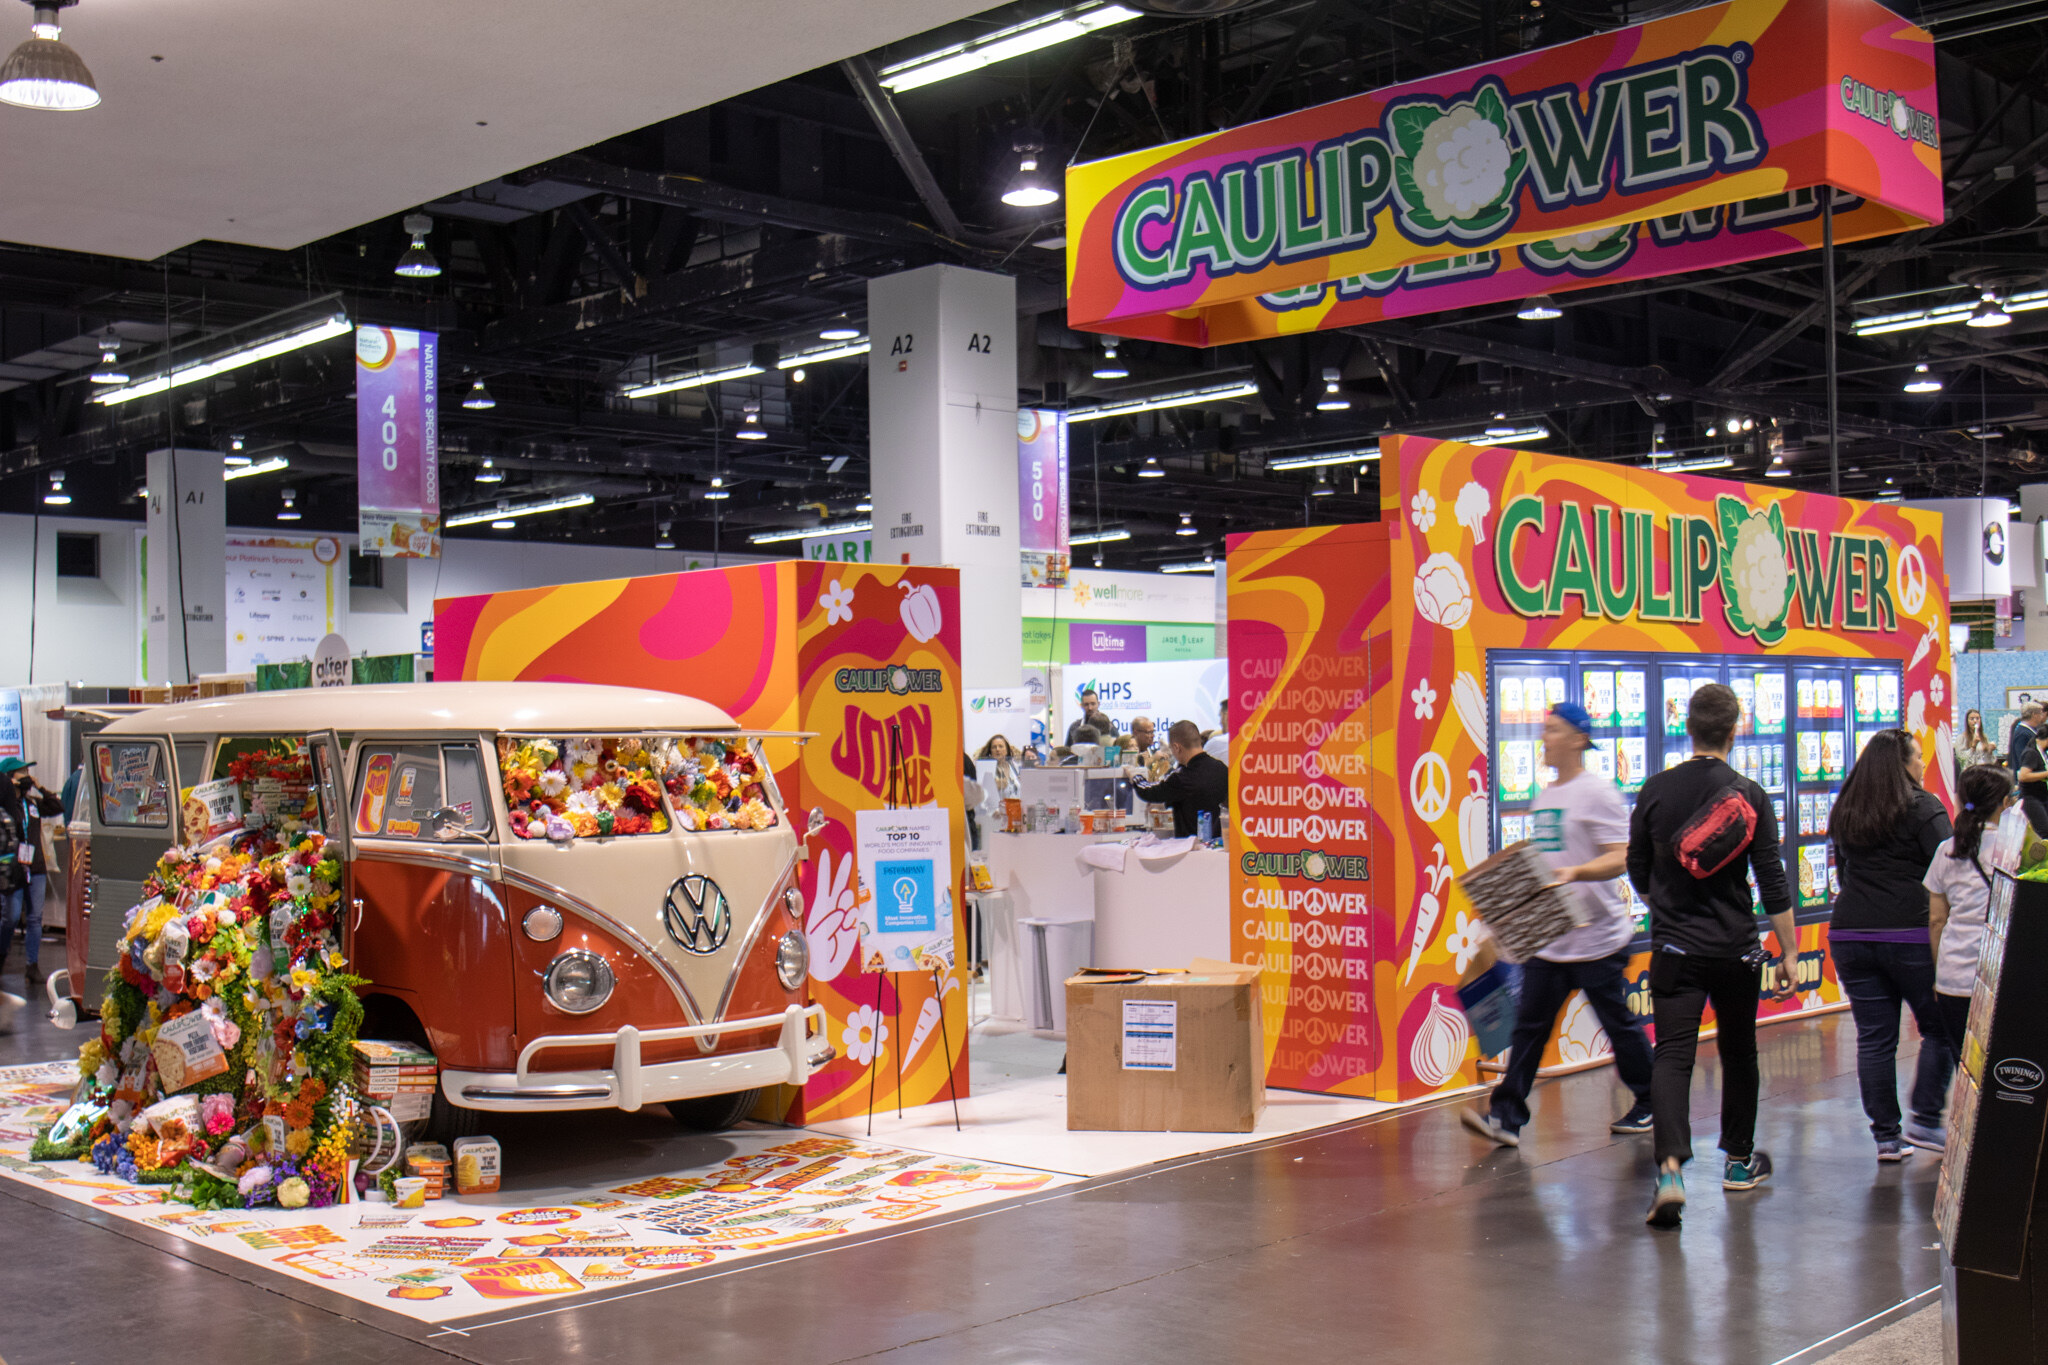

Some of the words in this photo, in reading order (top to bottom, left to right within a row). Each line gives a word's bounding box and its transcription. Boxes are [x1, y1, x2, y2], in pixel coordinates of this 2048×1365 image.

[890, 333, 913, 356] A2
[968, 333, 991, 354] A2
[424, 343, 433, 391] NATURAL
[425, 393, 434, 403] &
[382, 394, 397, 471] 400
[425, 408, 435, 465] SPECIALTY
[426, 465, 436, 504] FOODS
[1031, 461, 1043, 521] 500
[901, 512, 912, 524] FIRE
[977, 511, 988, 523] FIRE
[890, 524, 924, 539] EXTINGUISHER
[966, 523, 1000, 537] EXTINGUISHER
[240, 554, 271, 562] Platinum
[272, 556, 304, 565] Sponsors
[835, 664, 943, 695] CAULIPOWER
[1098, 681, 1132, 701] HPS
[987, 697, 1012, 708] HPS
[831, 703, 932, 799] JOIN
[864, 841, 890, 849] WORLD'S
[909, 839, 943, 847] INNOVATIVE
[886, 833, 906, 841] TOP
[909, 832, 920, 841] 10
[663, 874, 731, 956] VW
[1998, 1066, 2040, 1082] TWININGS
